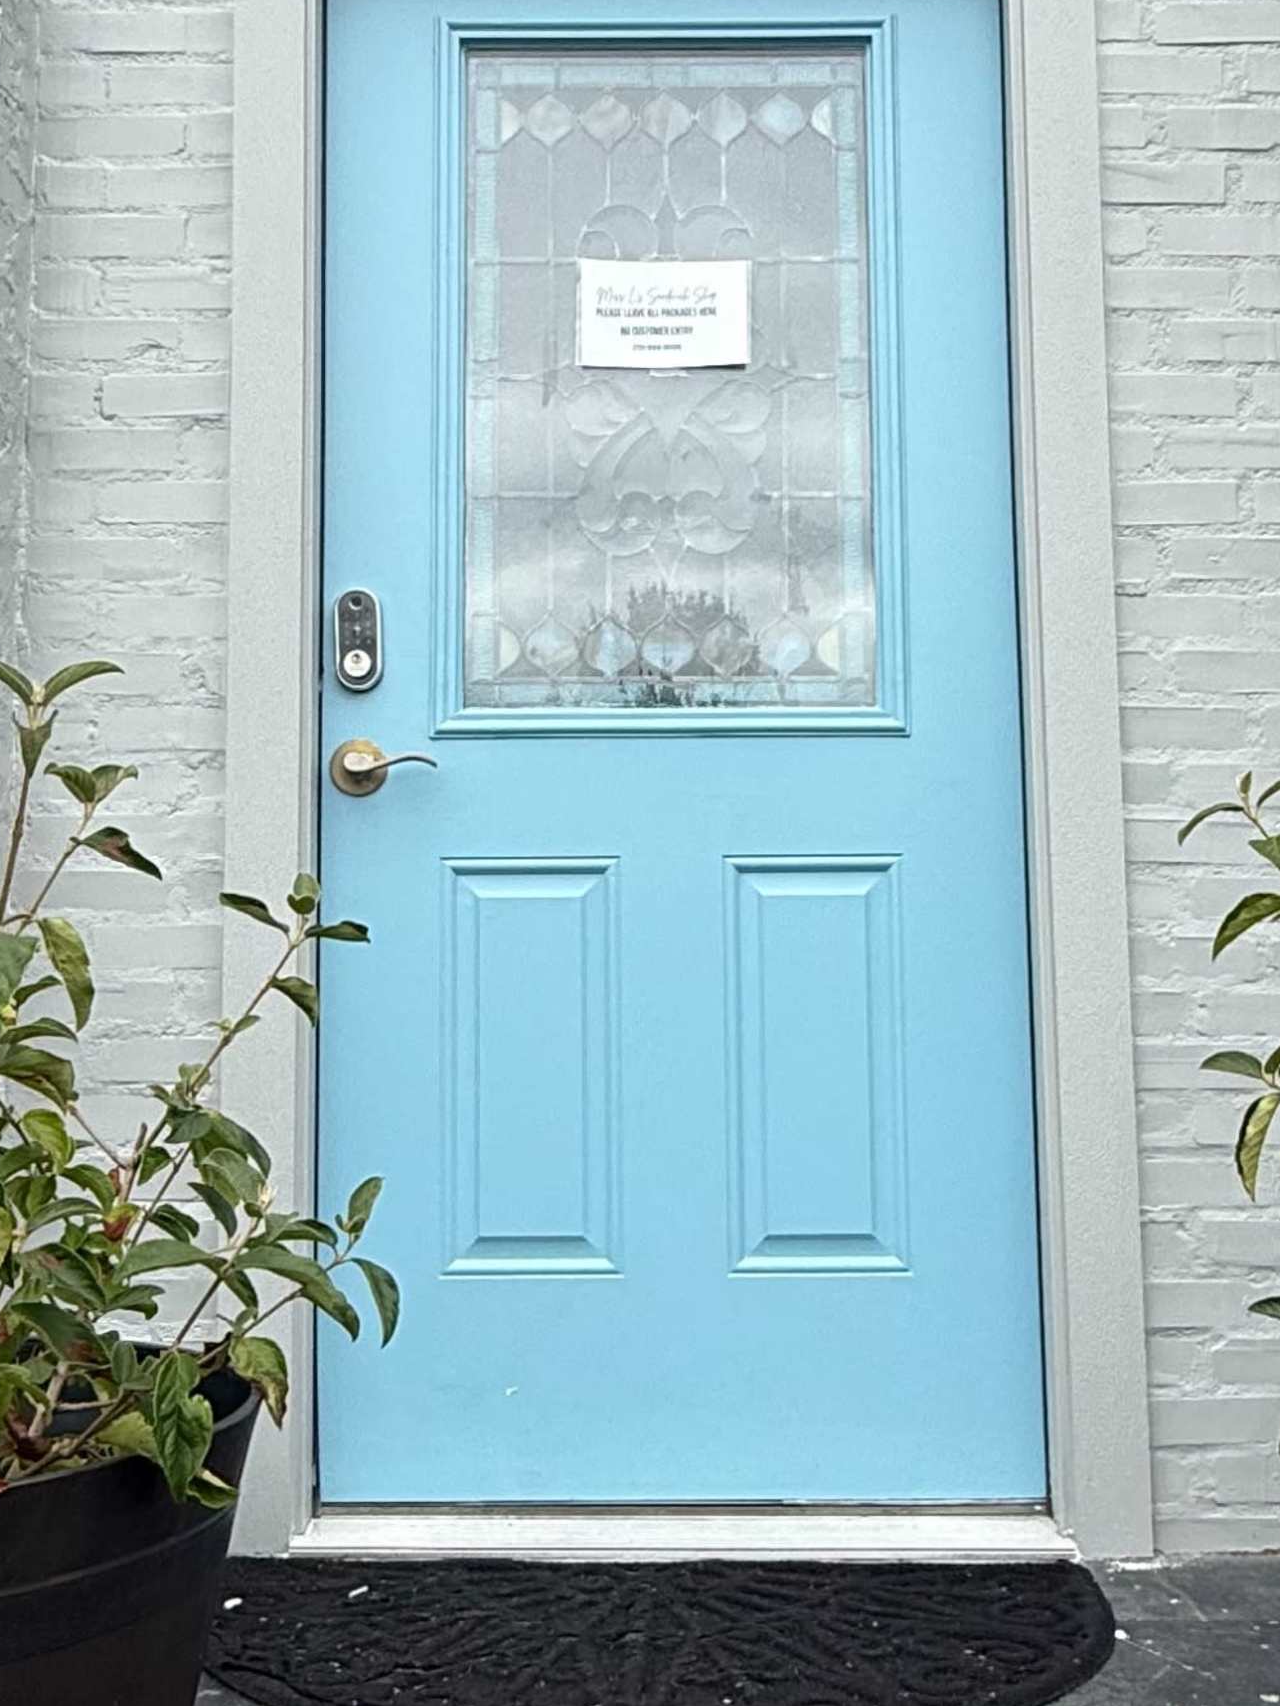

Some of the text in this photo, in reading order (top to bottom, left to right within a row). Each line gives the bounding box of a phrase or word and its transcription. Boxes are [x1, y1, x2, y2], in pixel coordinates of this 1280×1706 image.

[596, 307, 621, 318] PLEASE
[624, 307, 646, 318] LEAVE
[661, 307, 697, 318] PACKAGES
[699, 306, 717, 318] HERE
[632, 326, 669, 336] CUSTOMER
[670, 326, 693, 336] ENTRY
